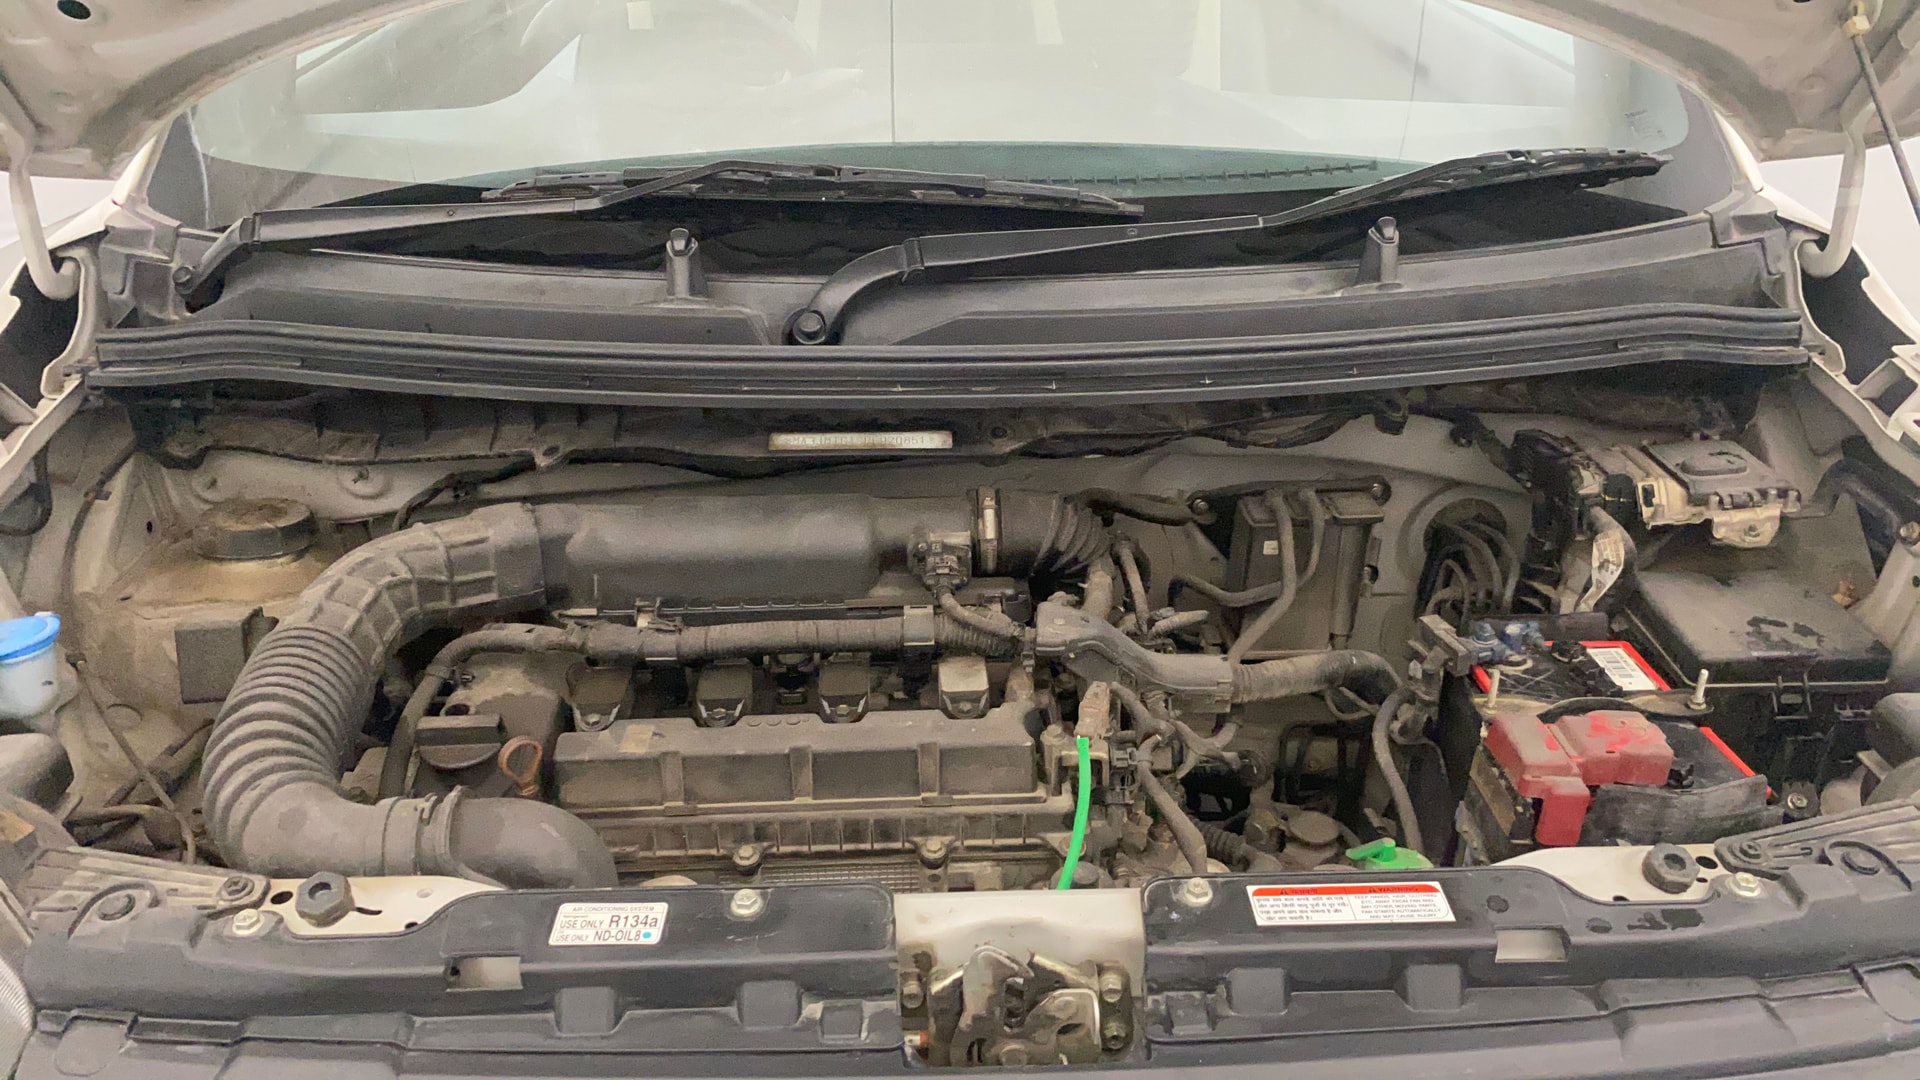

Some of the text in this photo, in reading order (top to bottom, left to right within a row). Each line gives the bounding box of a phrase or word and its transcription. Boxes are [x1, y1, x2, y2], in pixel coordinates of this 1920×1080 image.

[560, 914, 659, 929] USE ONLY R134a
[573, 934, 590, 942] ONLY
[593, 930, 642, 942] ND-OIL8
